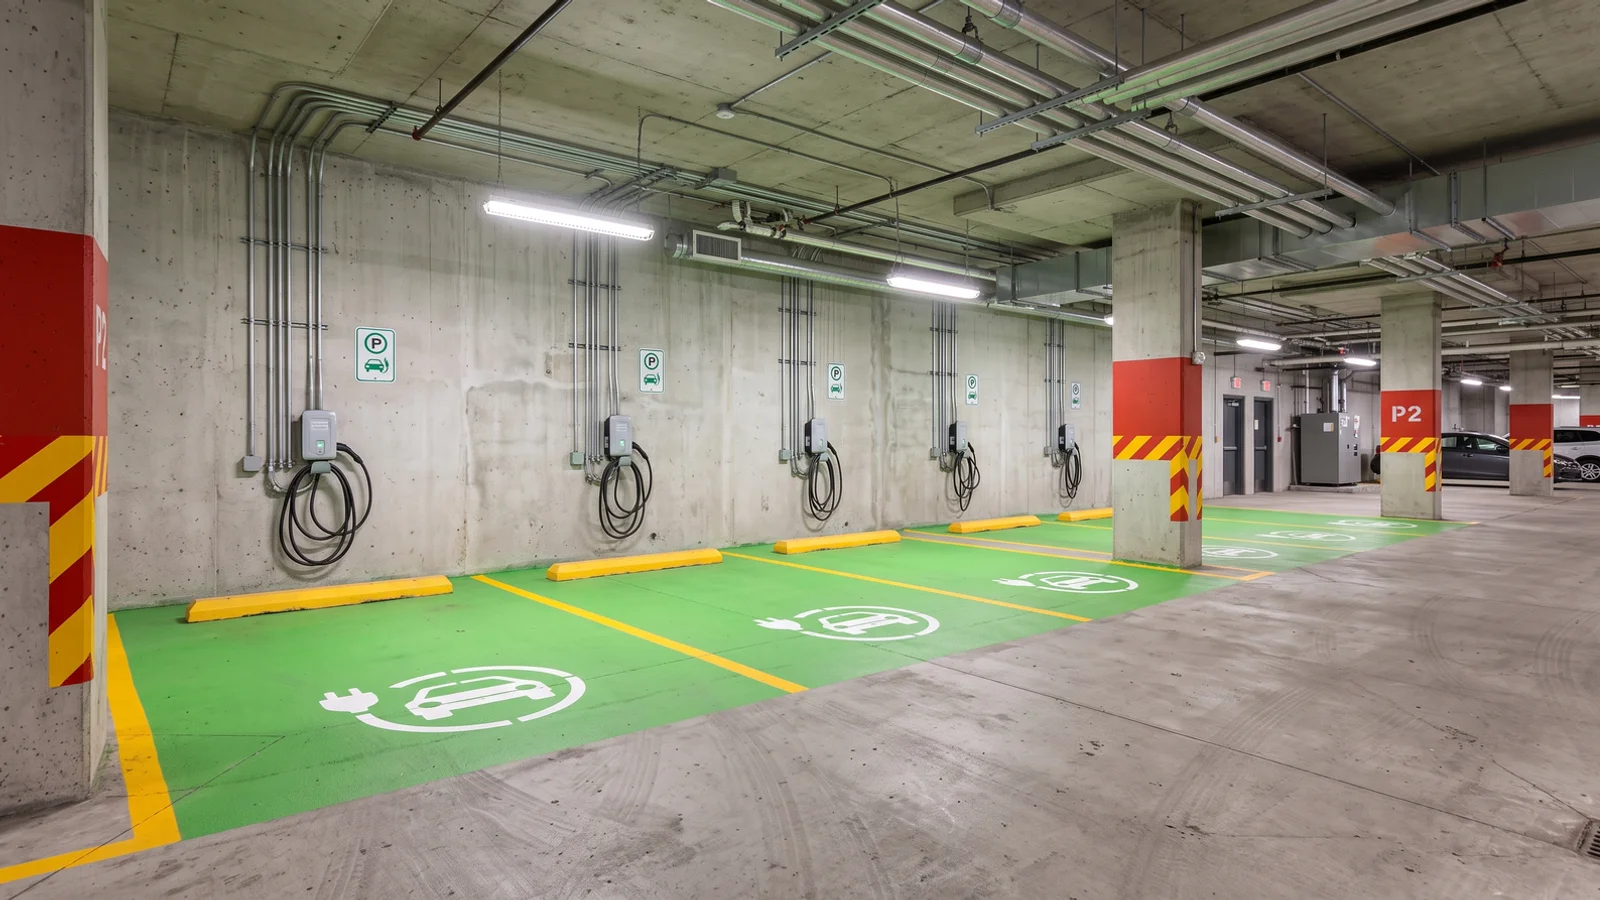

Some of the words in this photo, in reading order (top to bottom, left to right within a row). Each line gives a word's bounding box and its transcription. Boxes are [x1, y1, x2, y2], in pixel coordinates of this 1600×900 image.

[96, 304, 107, 370] P2
[372, 338, 382, 349] P
[648, 357, 656, 366] P
[1391, 405, 1422, 422] P2
